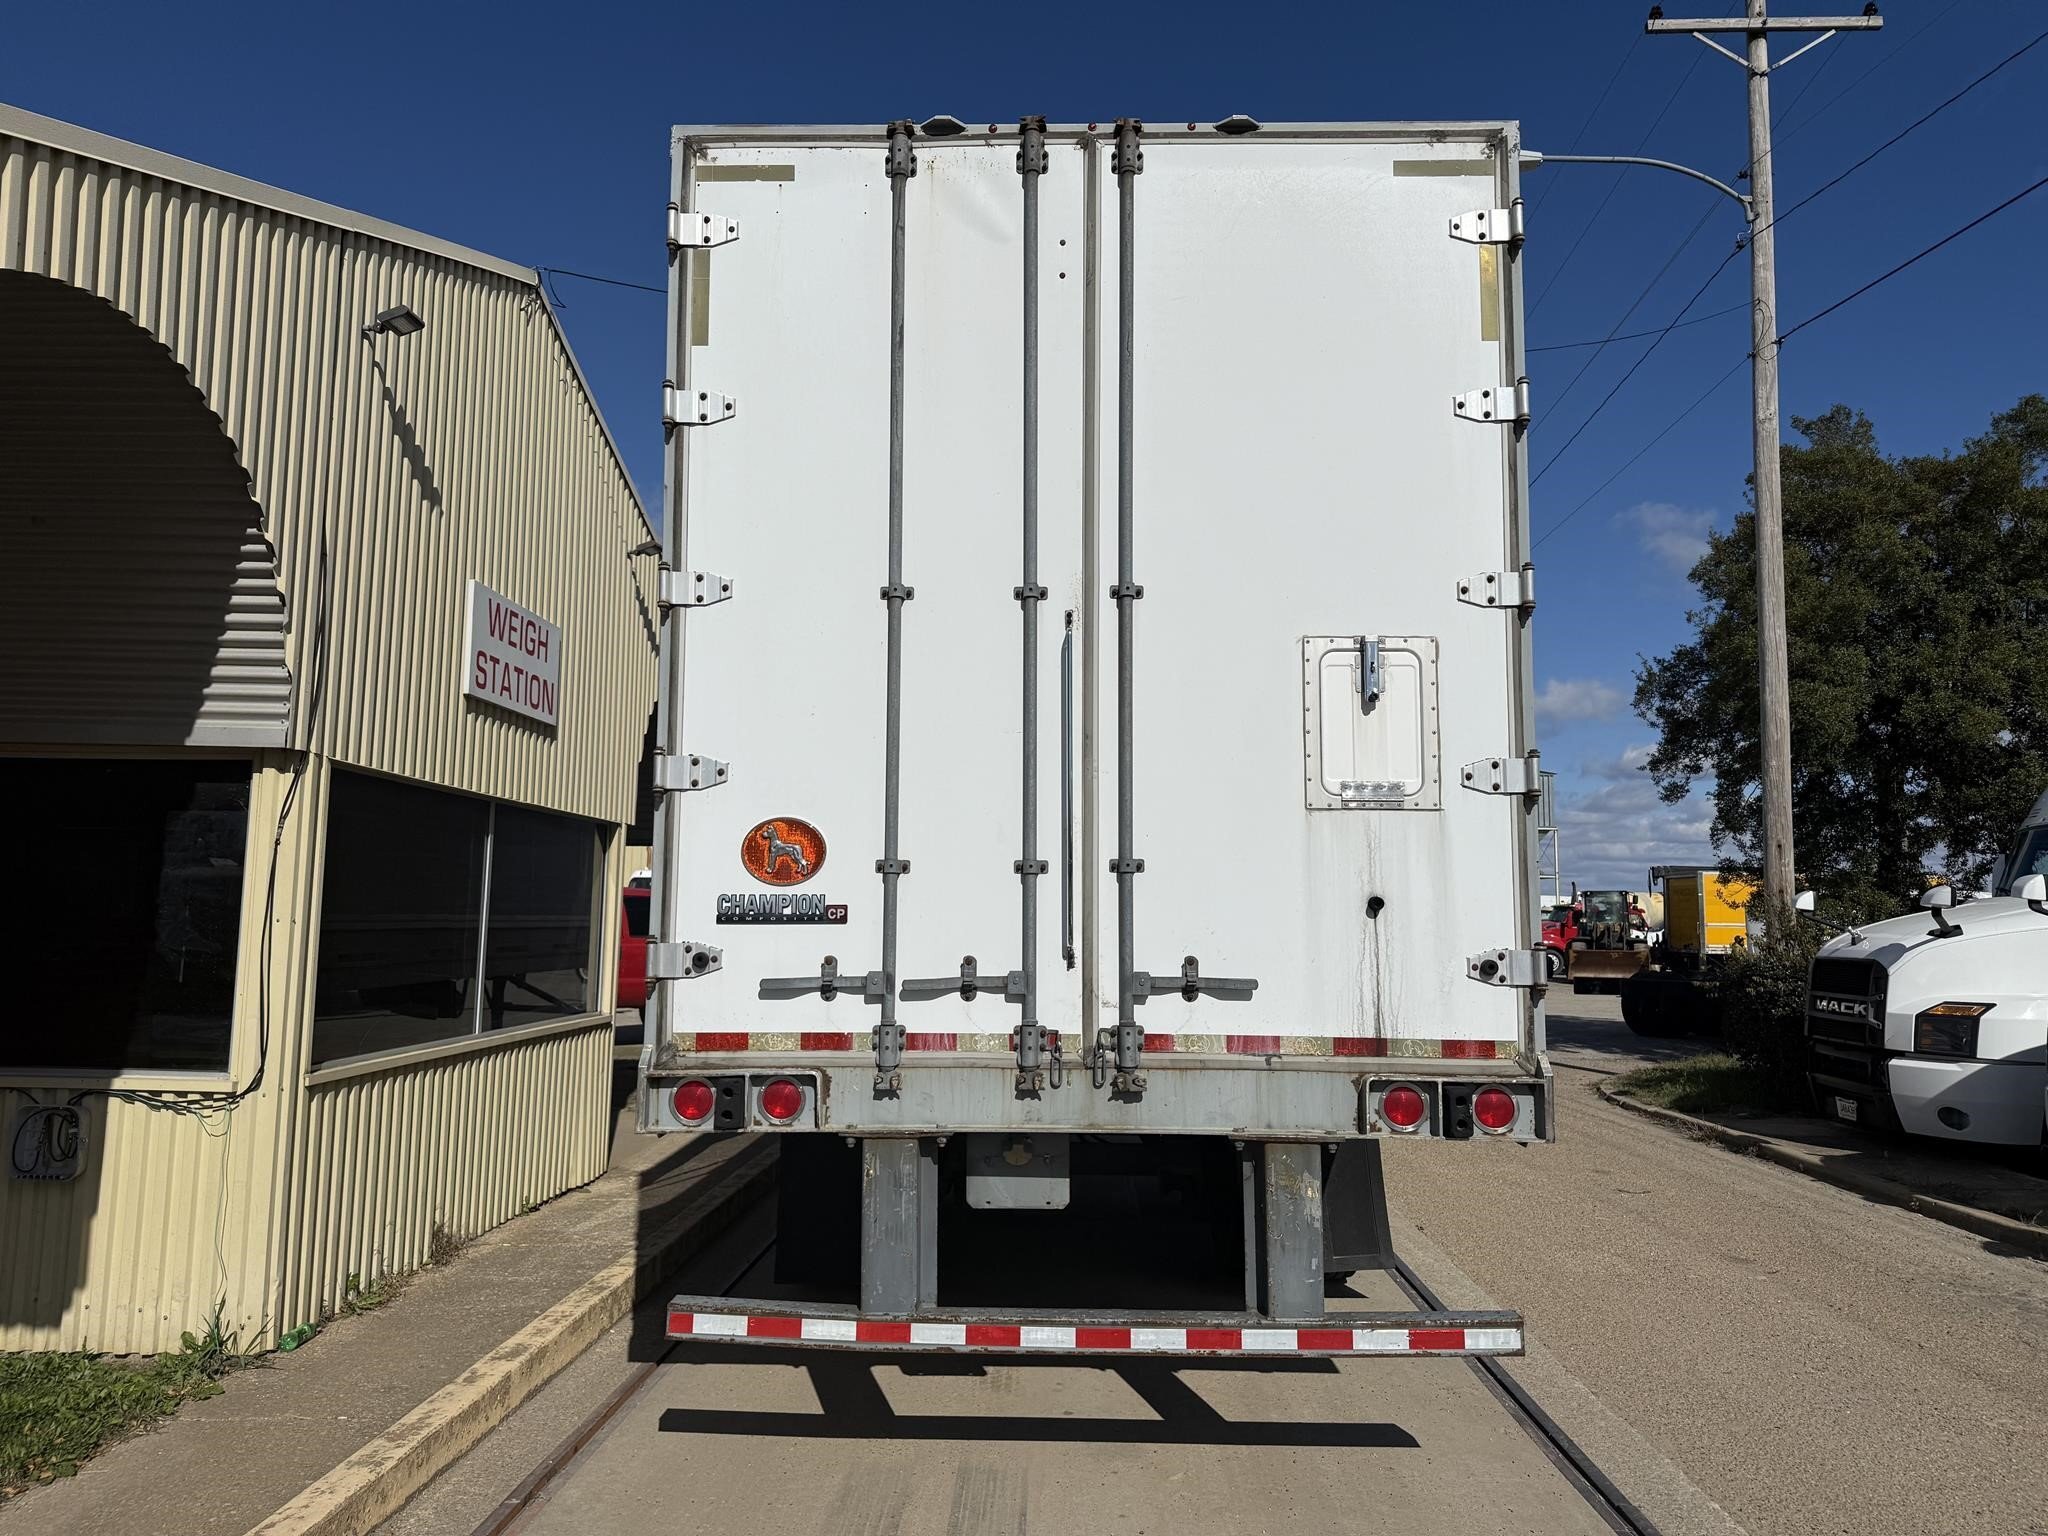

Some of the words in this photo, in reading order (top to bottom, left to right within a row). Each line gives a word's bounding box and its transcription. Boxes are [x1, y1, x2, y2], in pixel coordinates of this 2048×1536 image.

[488, 598, 549, 663] WEIGH
[475, 650, 554, 716] STATION
[716, 893, 826, 915] CHAMPION
[827, 908, 846, 920] CP
[1816, 999, 1868, 1016] MACK
